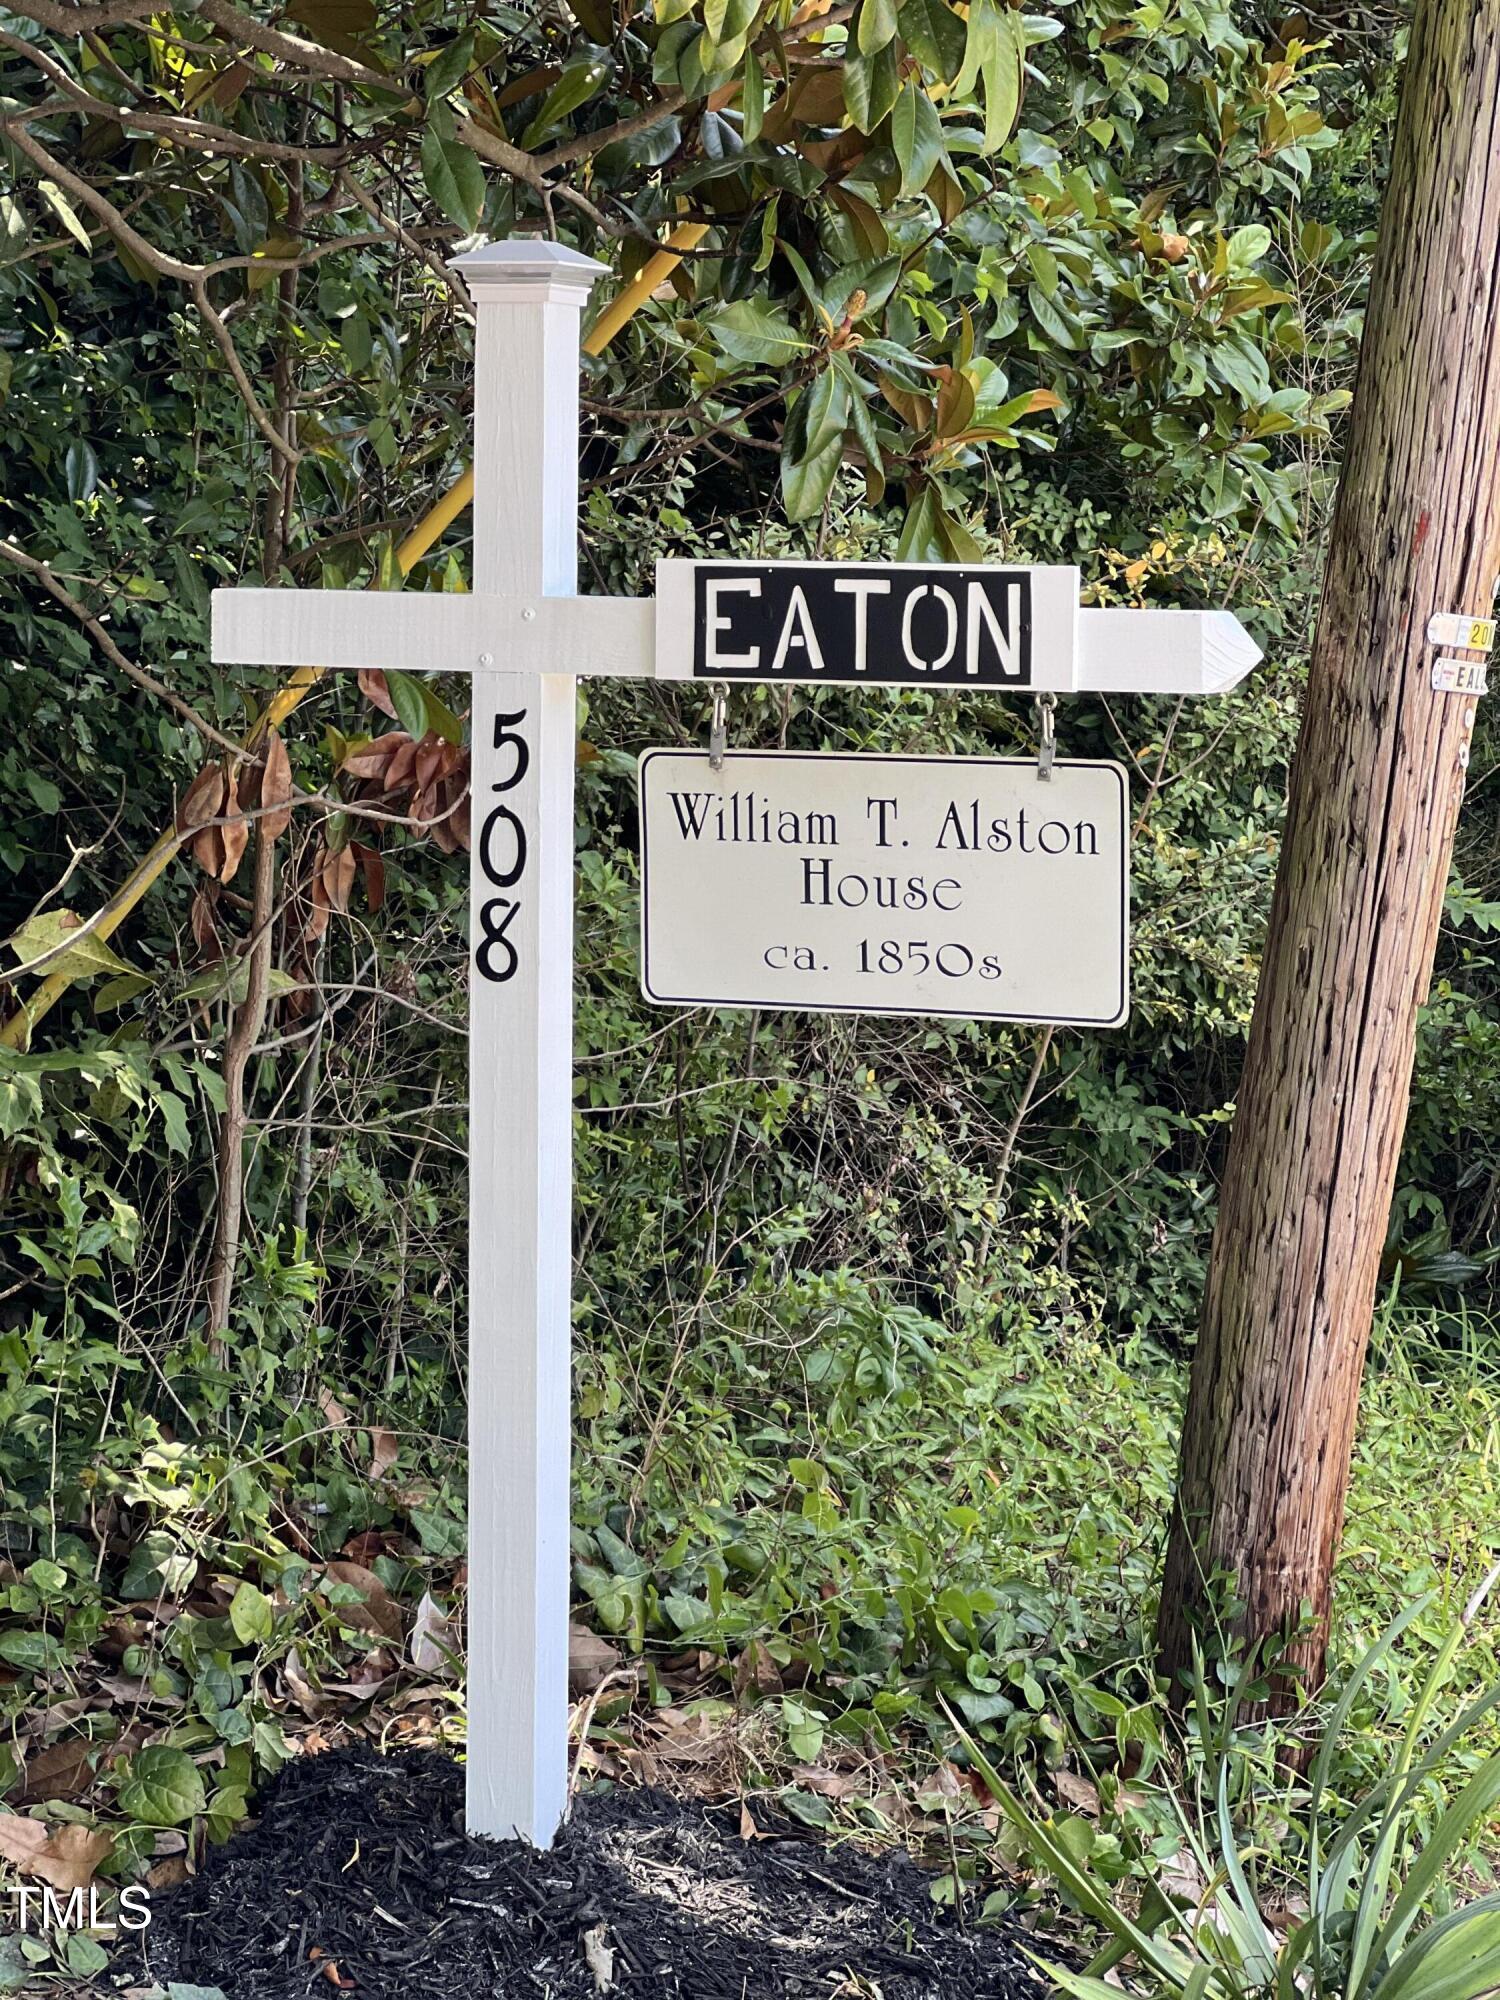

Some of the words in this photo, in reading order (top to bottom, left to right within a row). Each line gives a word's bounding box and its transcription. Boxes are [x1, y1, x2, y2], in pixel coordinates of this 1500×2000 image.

[704, 576, 1021, 676] EATON
[475, 708, 530, 983] 508
[667, 791, 840, 845] William
[867, 796, 909, 847] T.
[935, 799, 1100, 855] Alston
[799, 857, 962, 911] House
[764, 946, 829, 971] ca.
[856, 939, 1002, 981] 1850s
